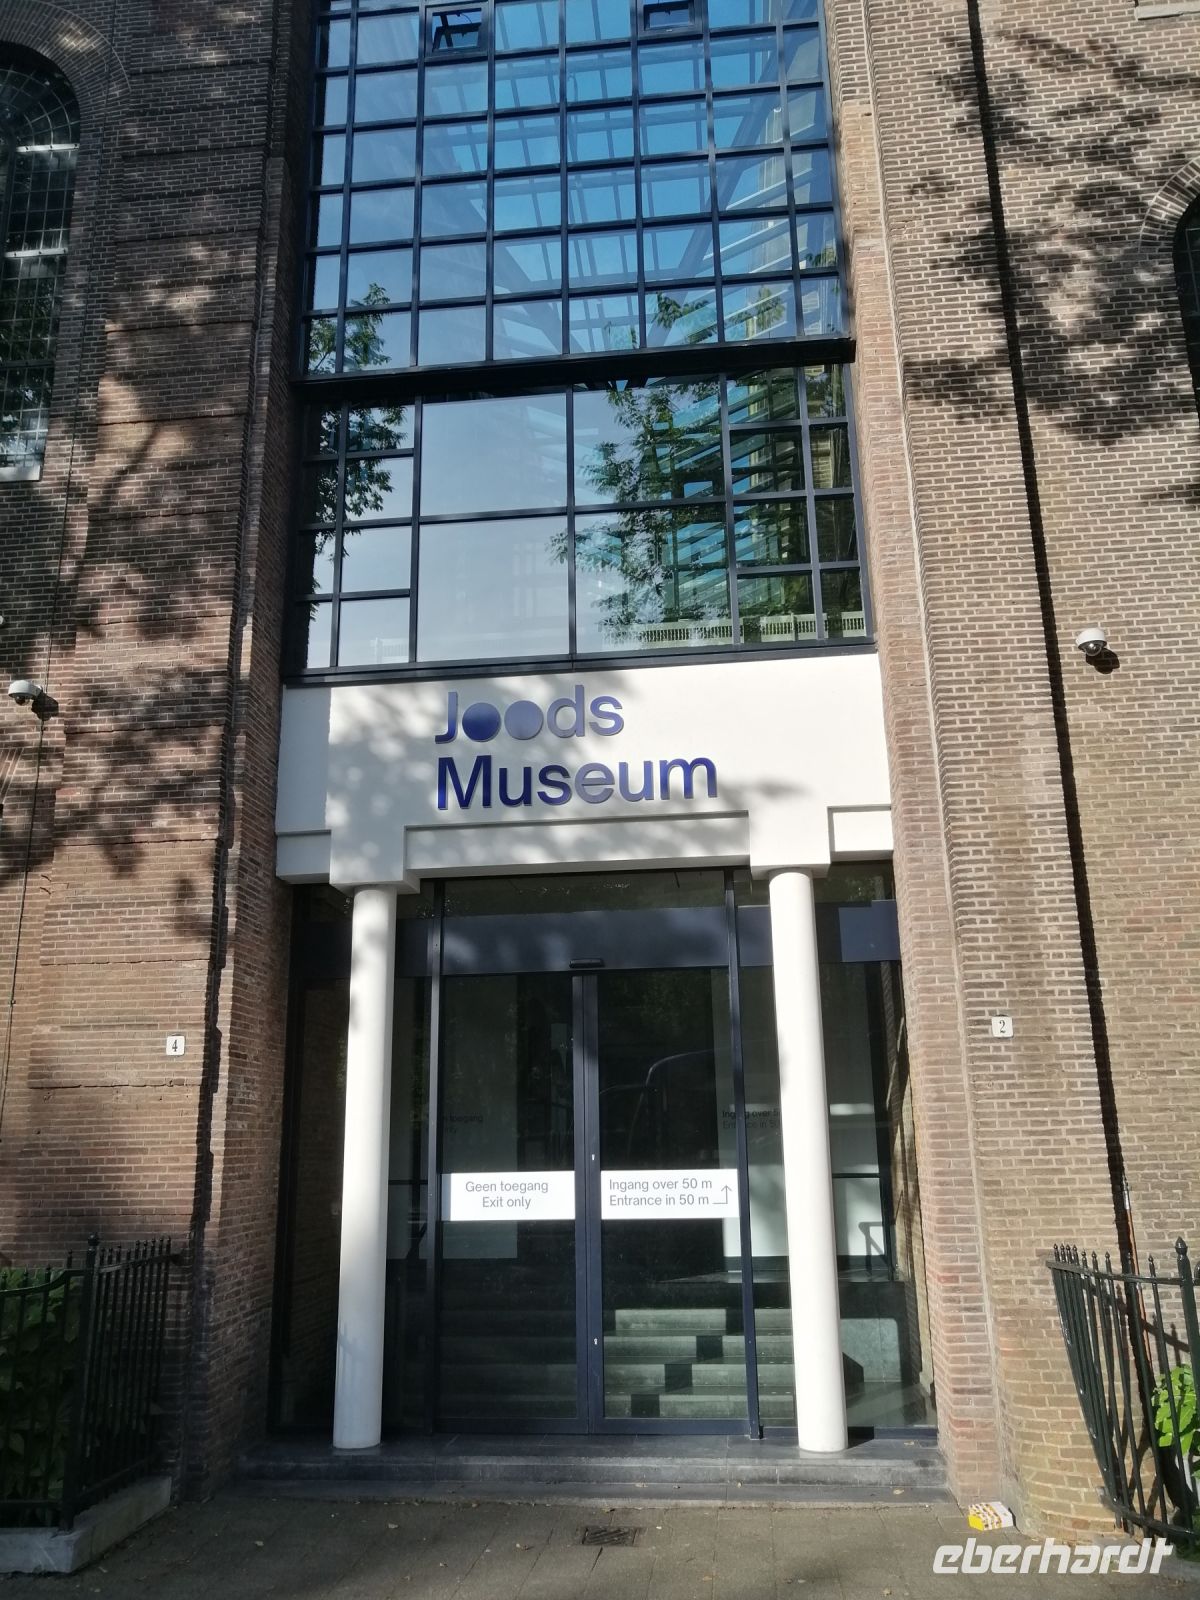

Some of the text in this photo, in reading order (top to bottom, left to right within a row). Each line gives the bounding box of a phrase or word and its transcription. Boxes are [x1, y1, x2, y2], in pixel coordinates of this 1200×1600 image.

[435, 685, 625, 744] Joods
[437, 755, 718, 811] Museum
[465, 1180, 549, 1194] Geen toegang
[609, 1178, 712, 1193] Ingang over 50 m
[482, 1196, 532, 1210] Exit only
[609, 1194, 710, 1206] Entrance in 50 m
